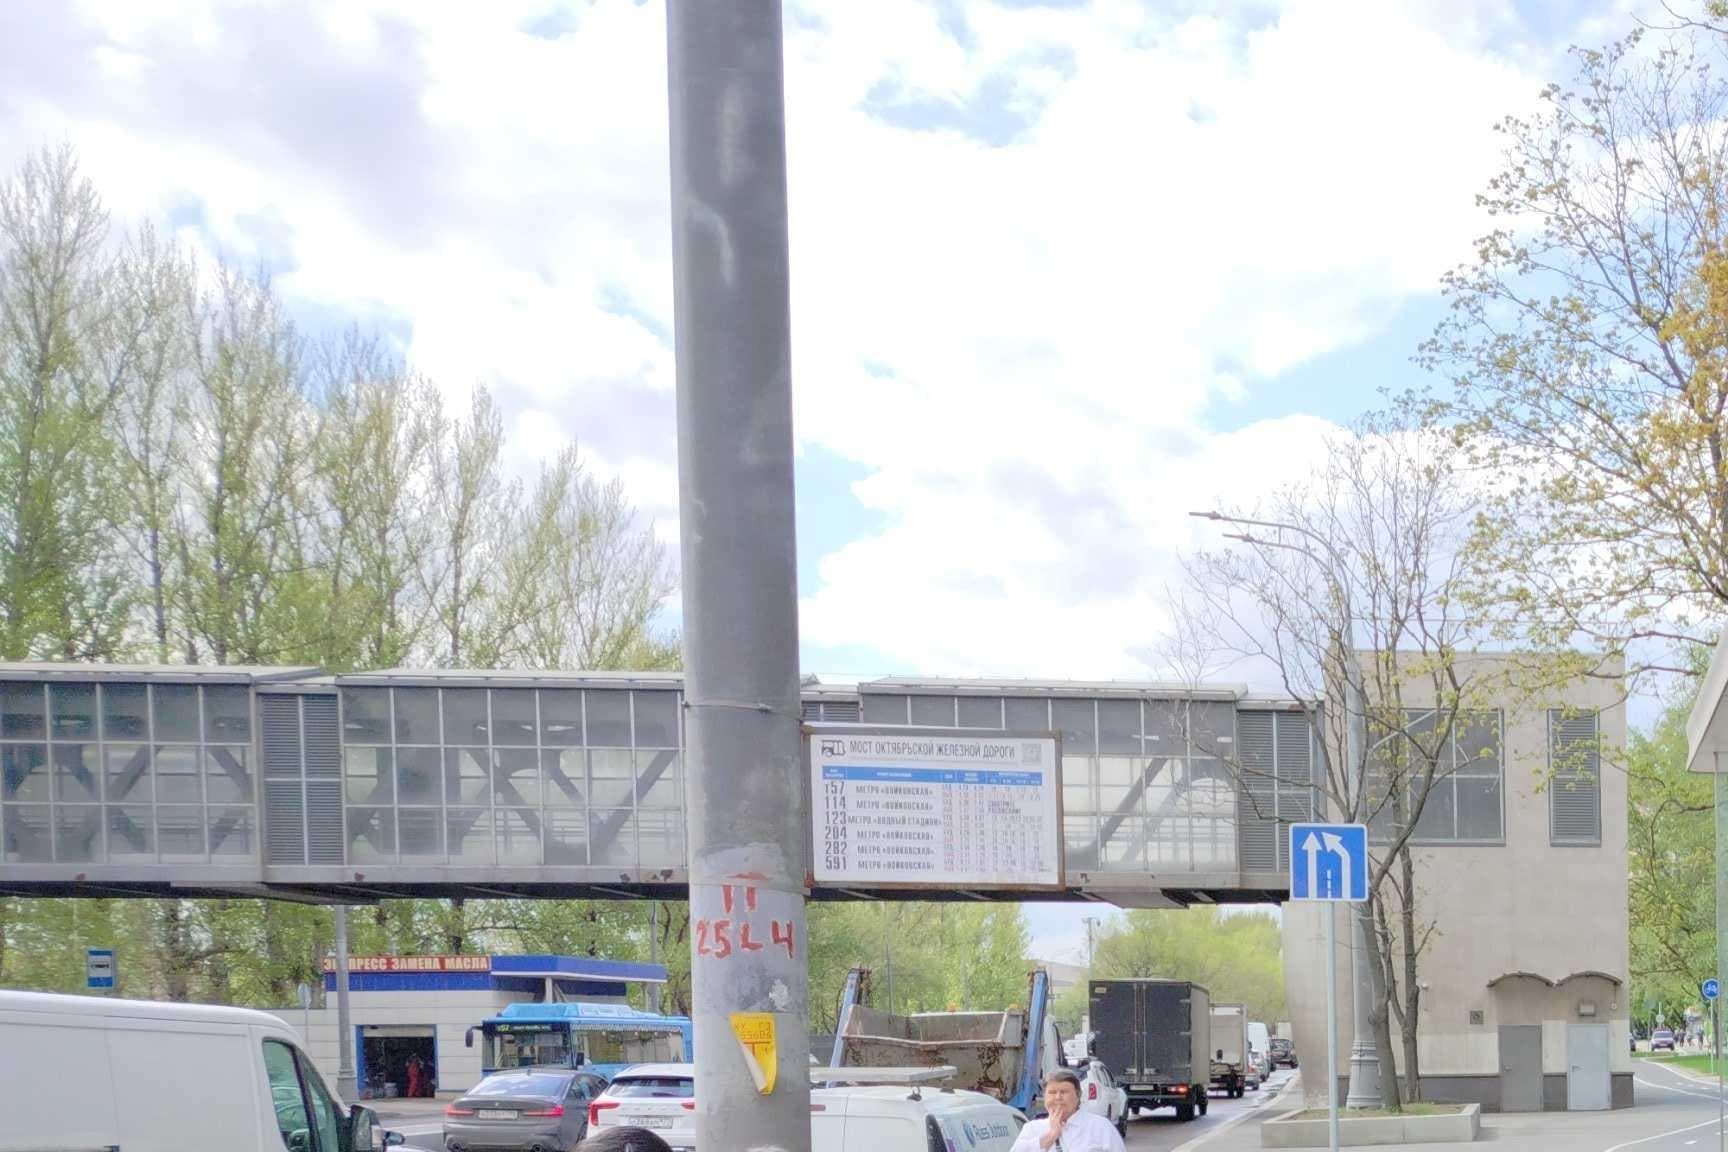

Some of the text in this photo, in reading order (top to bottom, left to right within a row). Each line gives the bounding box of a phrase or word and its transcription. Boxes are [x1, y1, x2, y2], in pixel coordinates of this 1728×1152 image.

[849, 740, 1015, 759] МОСТ ОКТЯБРЬСКОЙ ЖЕЛЕЗНОЙ ДОРОГИ
[824, 796, 847, 810] 114
[825, 811, 847, 825] 123
[323, 957, 488, 970] ЭПРЕСС ЗАМЕНА МАСЛА
